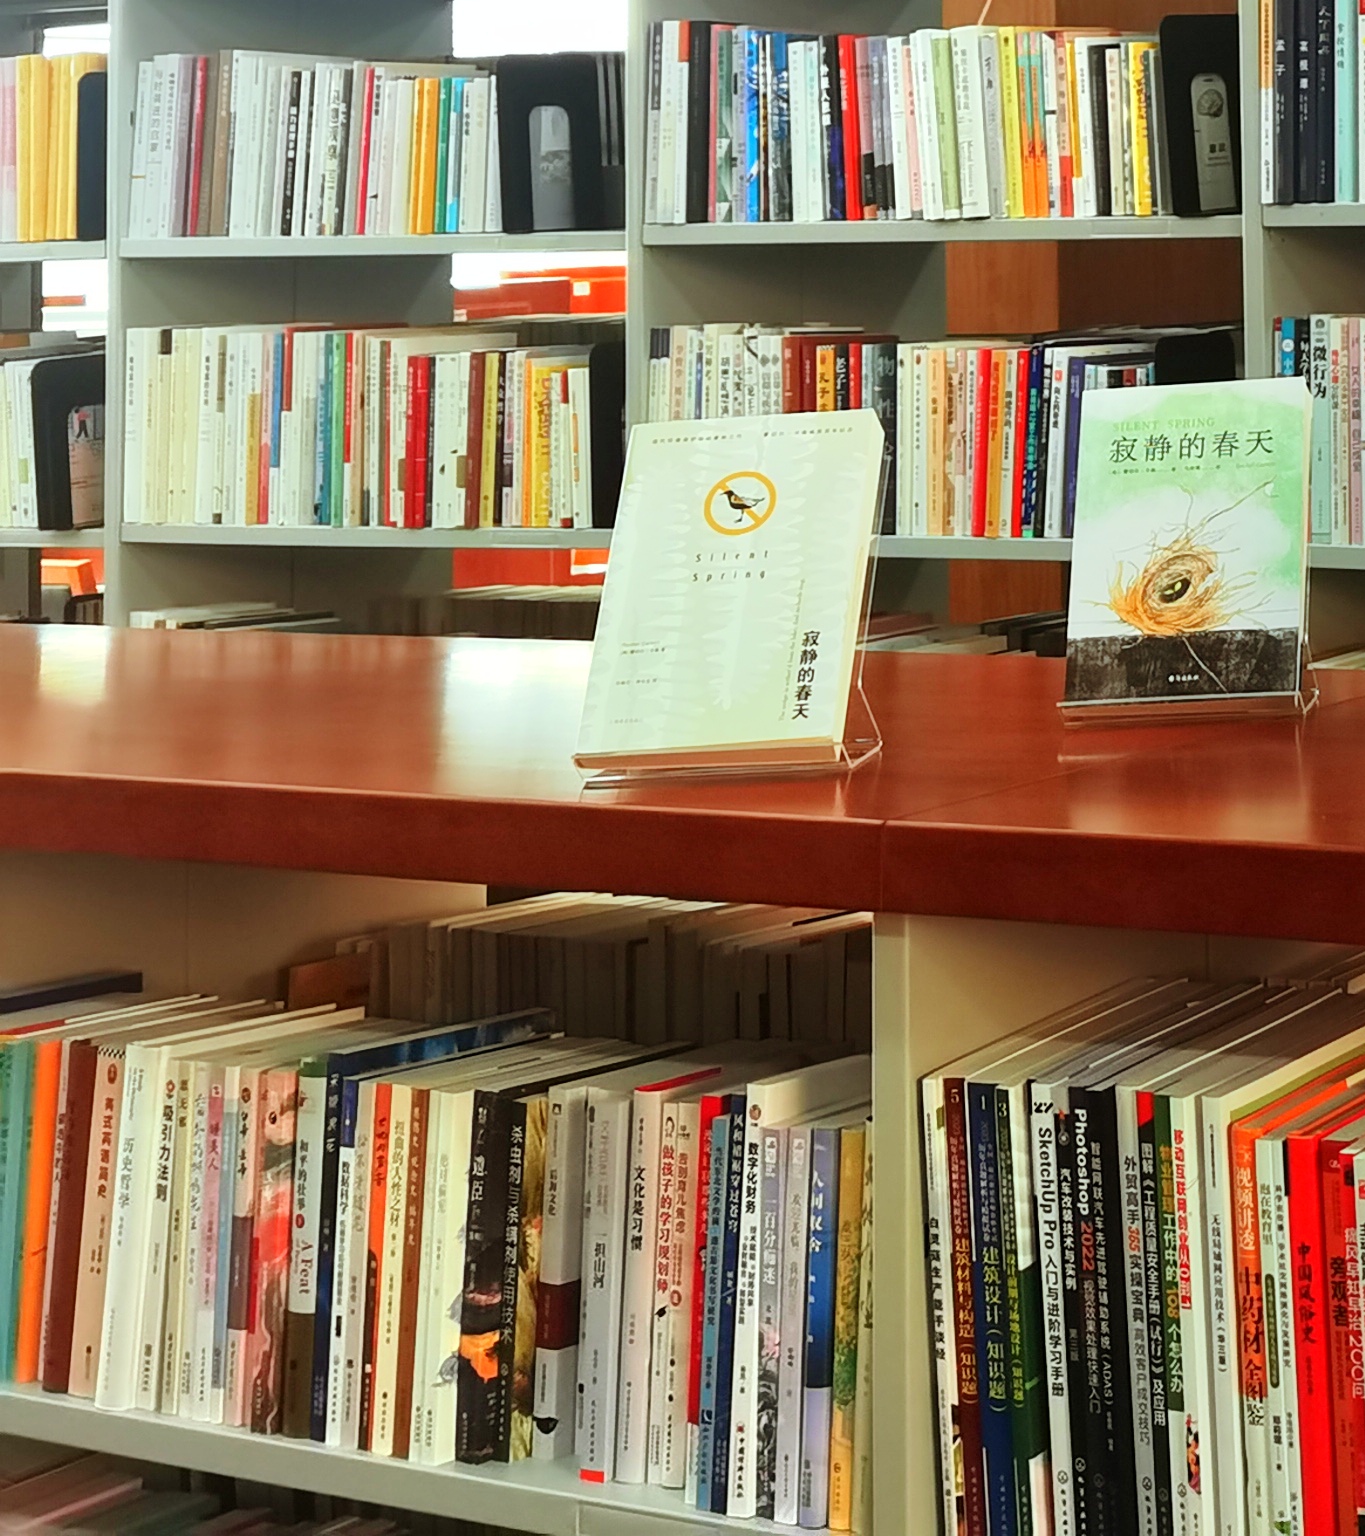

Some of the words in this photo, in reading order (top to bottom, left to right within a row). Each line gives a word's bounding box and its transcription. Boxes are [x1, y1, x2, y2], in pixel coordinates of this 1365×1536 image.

[1313, 346, 1327, 398] 微行为
[1109, 429, 1274, 463] 寂静的春天
[1113, 420, 1159, 433] SILENT
[1167, 417, 1215, 430] SPRING
[691, 570, 766, 583] Spring
[695, 550, 769, 563] Silent
[791, 630, 821, 720] 寂静的春天
[950, 1088, 960, 1104] 5
[118, 1137, 135, 1208] 历史哲学
[156, 1105, 174, 1203] 吸引力法则
[744, 1141, 760, 1215] 数字化财务
[1039, 1127, 1053, 1214] SketchUp
[1074, 1108, 1090, 1215] Photoshop
[631, 1166, 646, 1252] 文化是习惯
[656, 1144, 676, 1296] 做孩子的学习规划师
[1043, 1219, 1057, 1250] Pro
[1060, 1167, 1077, 1291] 汽车改装技术与实例
[1081, 1223, 1095, 1272] 2022
[1124, 1155, 1145, 1324] 外贸高手365实操宝典
[1236, 1167, 1256, 1251] 视频讲透
[983, 1245, 1007, 1413] 建筑设计（知识题）
[1043, 1252, 1066, 1398] 入门与进阶学习手册
[1242, 1264, 1266, 1355] 中药材
